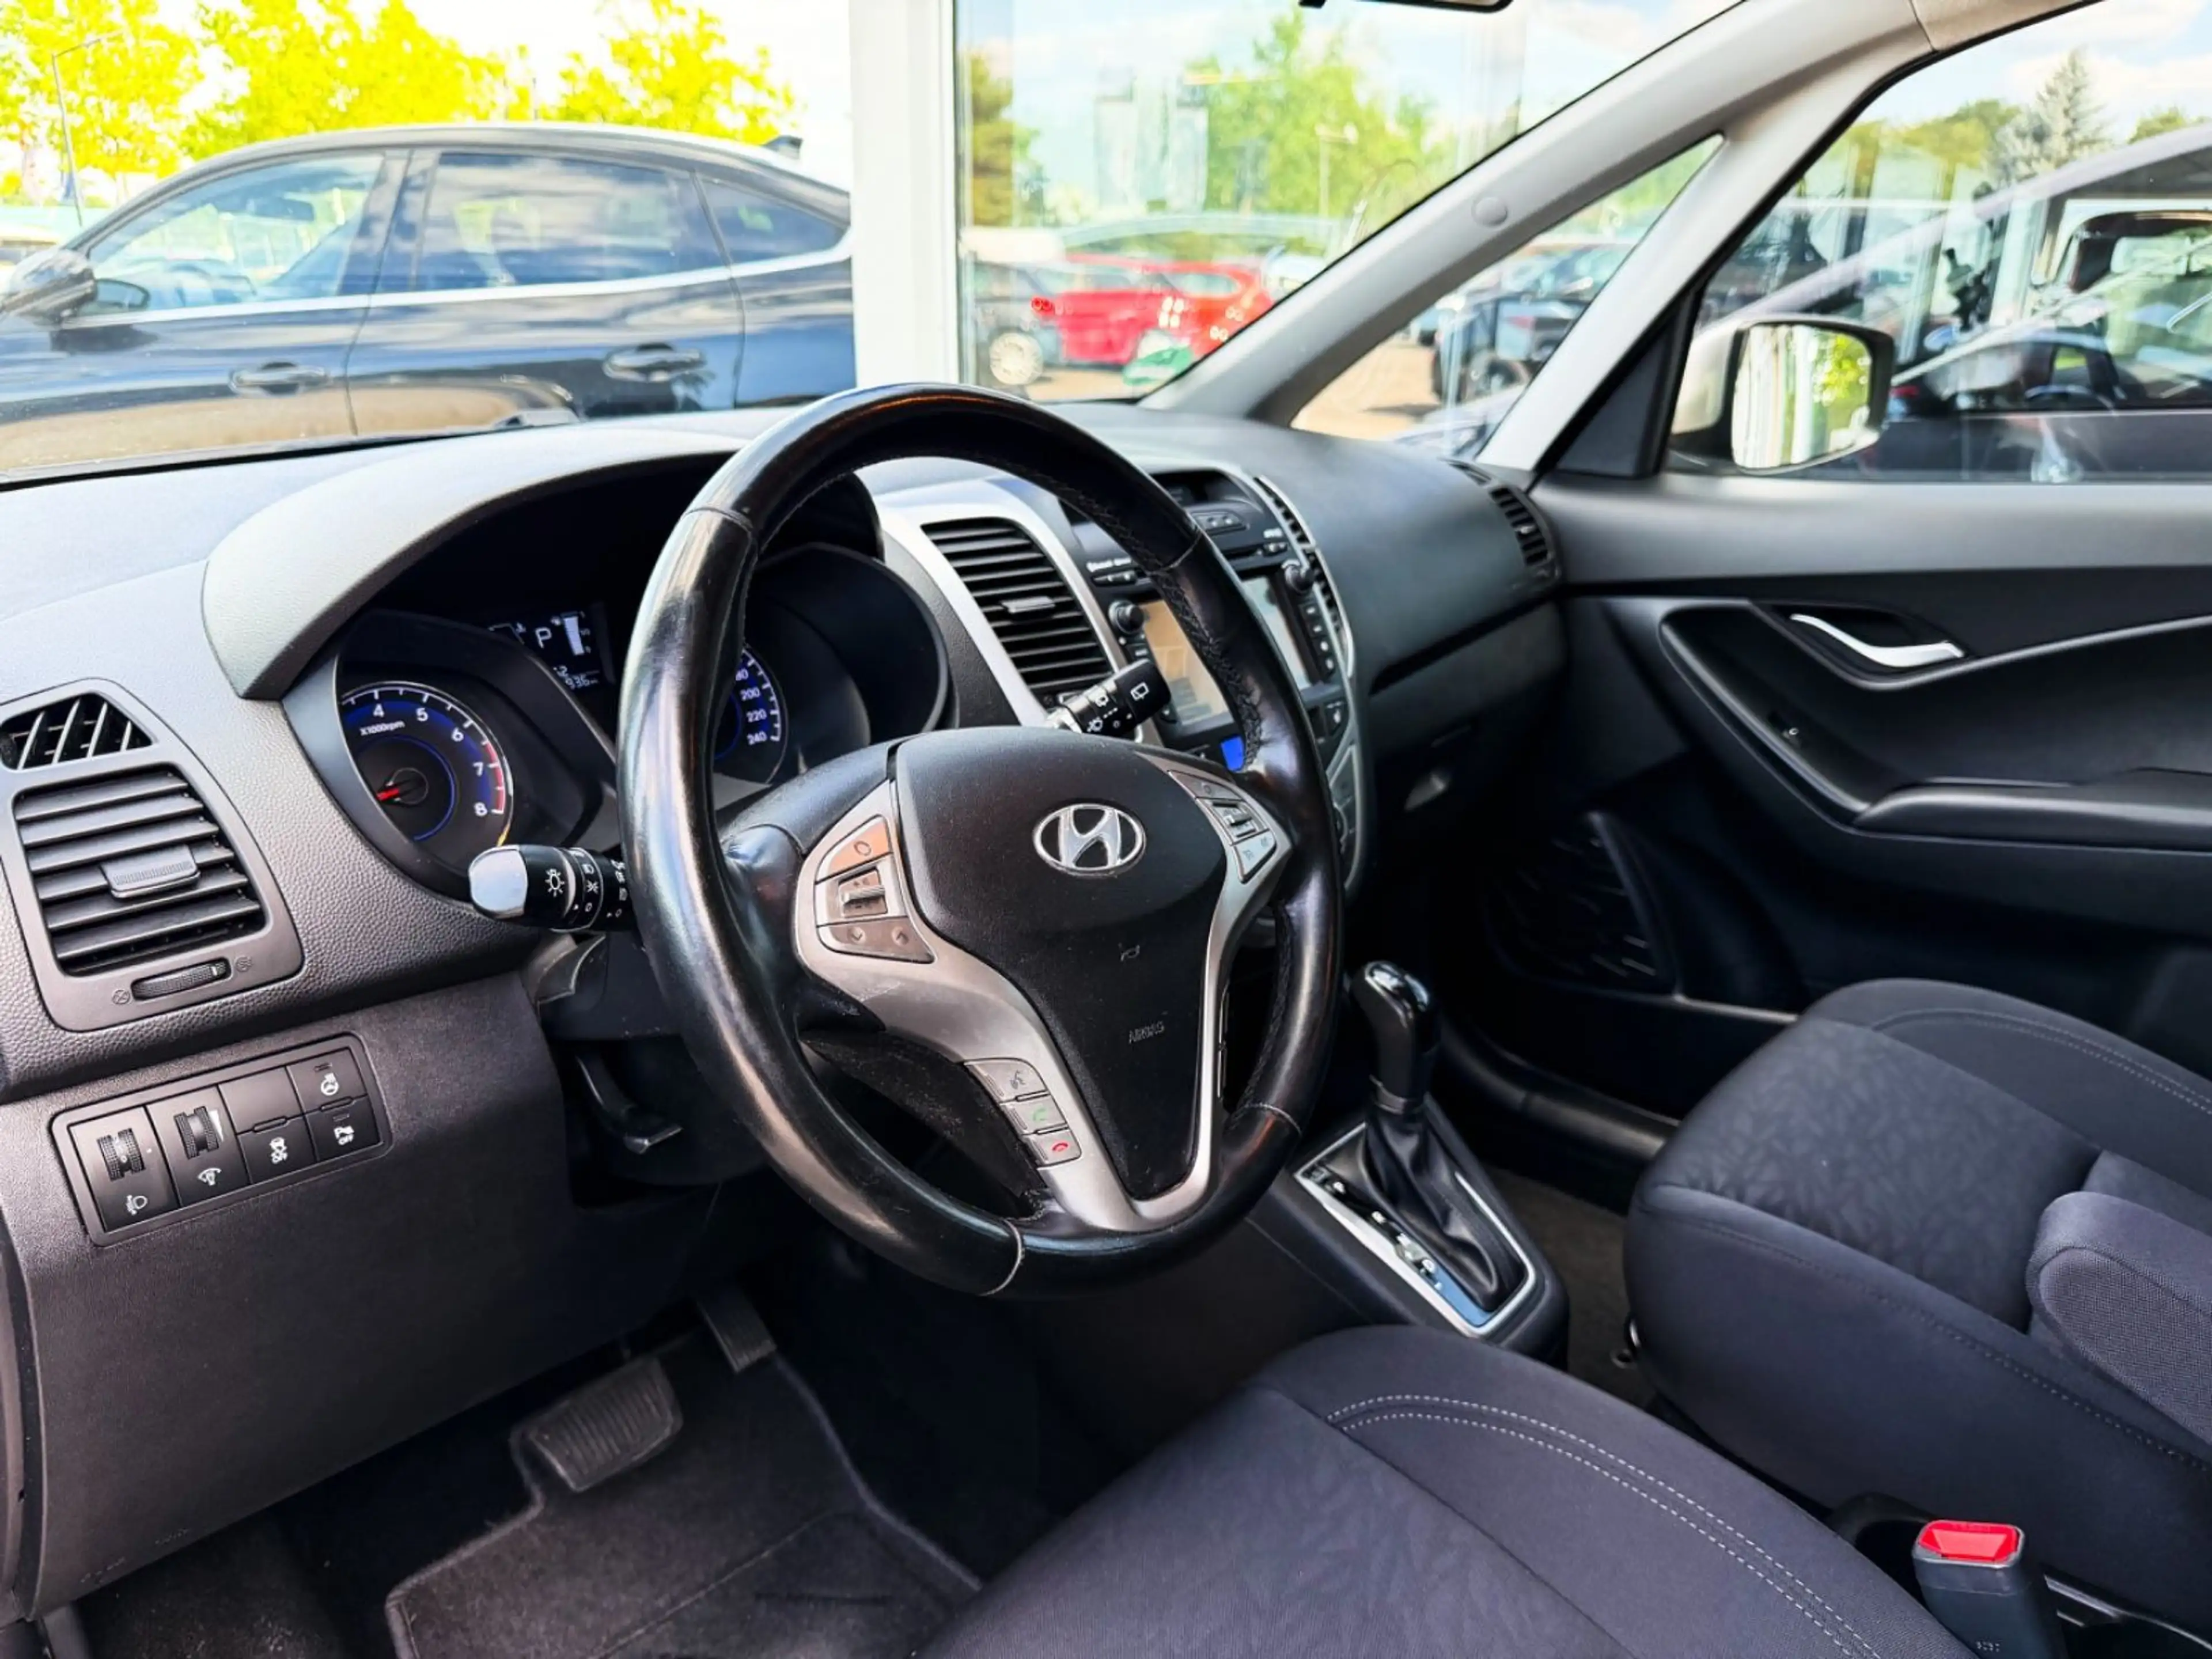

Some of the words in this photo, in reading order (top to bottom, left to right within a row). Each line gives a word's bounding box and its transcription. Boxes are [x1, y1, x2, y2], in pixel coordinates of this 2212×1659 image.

[535, 627, 552, 649] P
[740, 687, 760, 701] 200
[373, 704, 385, 718] 4
[416, 707, 429, 721] 5
[747, 709, 767, 722] 220
[451, 727, 464, 742] 6
[747, 730, 767, 745] 240
[473, 762, 483, 776] 7
[474, 802, 487, 817] 8
